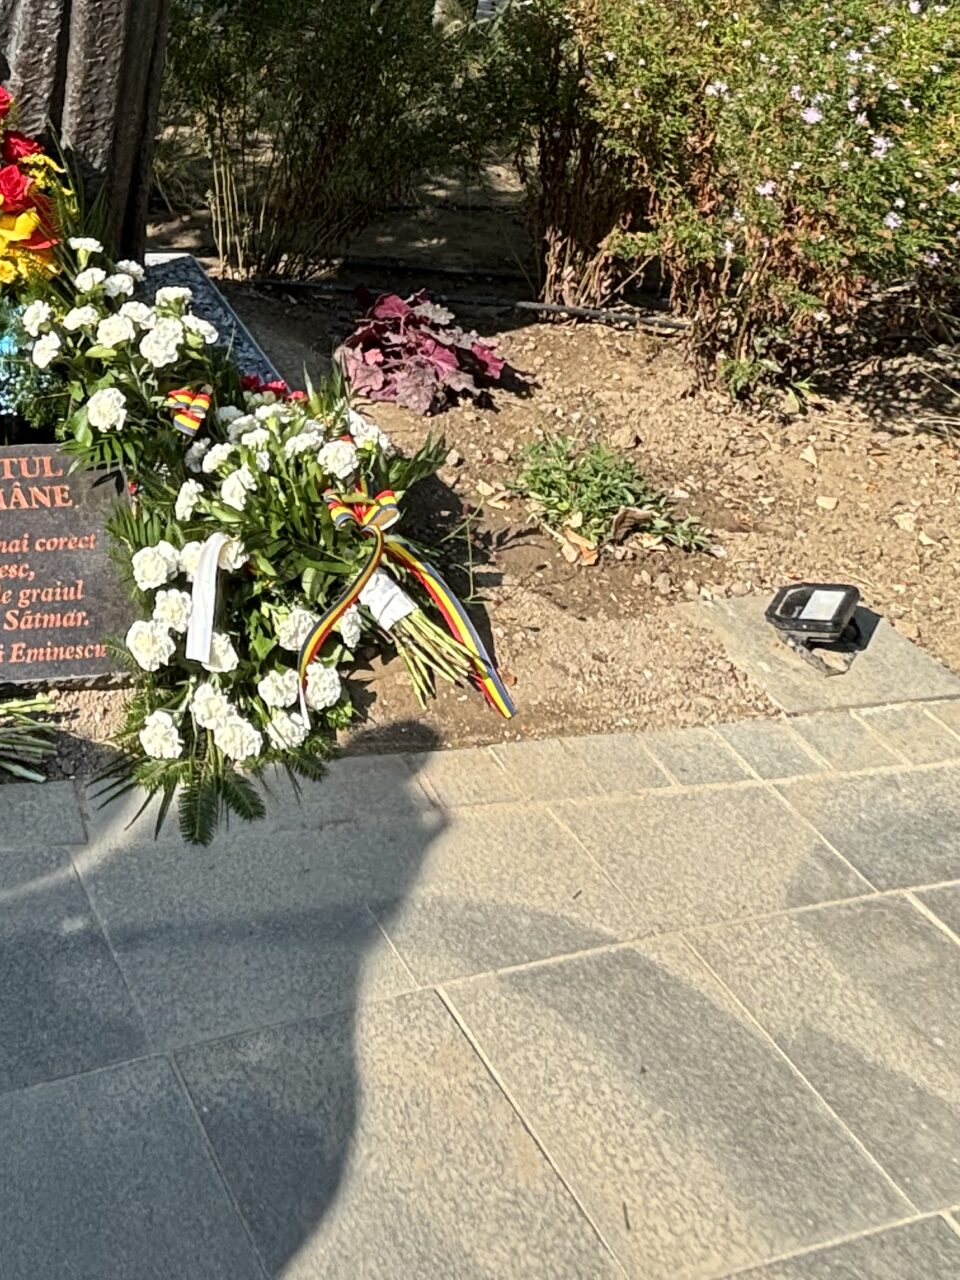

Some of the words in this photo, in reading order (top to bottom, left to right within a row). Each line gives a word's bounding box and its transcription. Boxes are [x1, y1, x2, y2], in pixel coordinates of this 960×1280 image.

[34, 533, 97, 552] corect
[18, 579, 84, 609] graiul
[3, 608, 90, 632] Sătmar.
[9, 641, 108, 665] Eminescu
